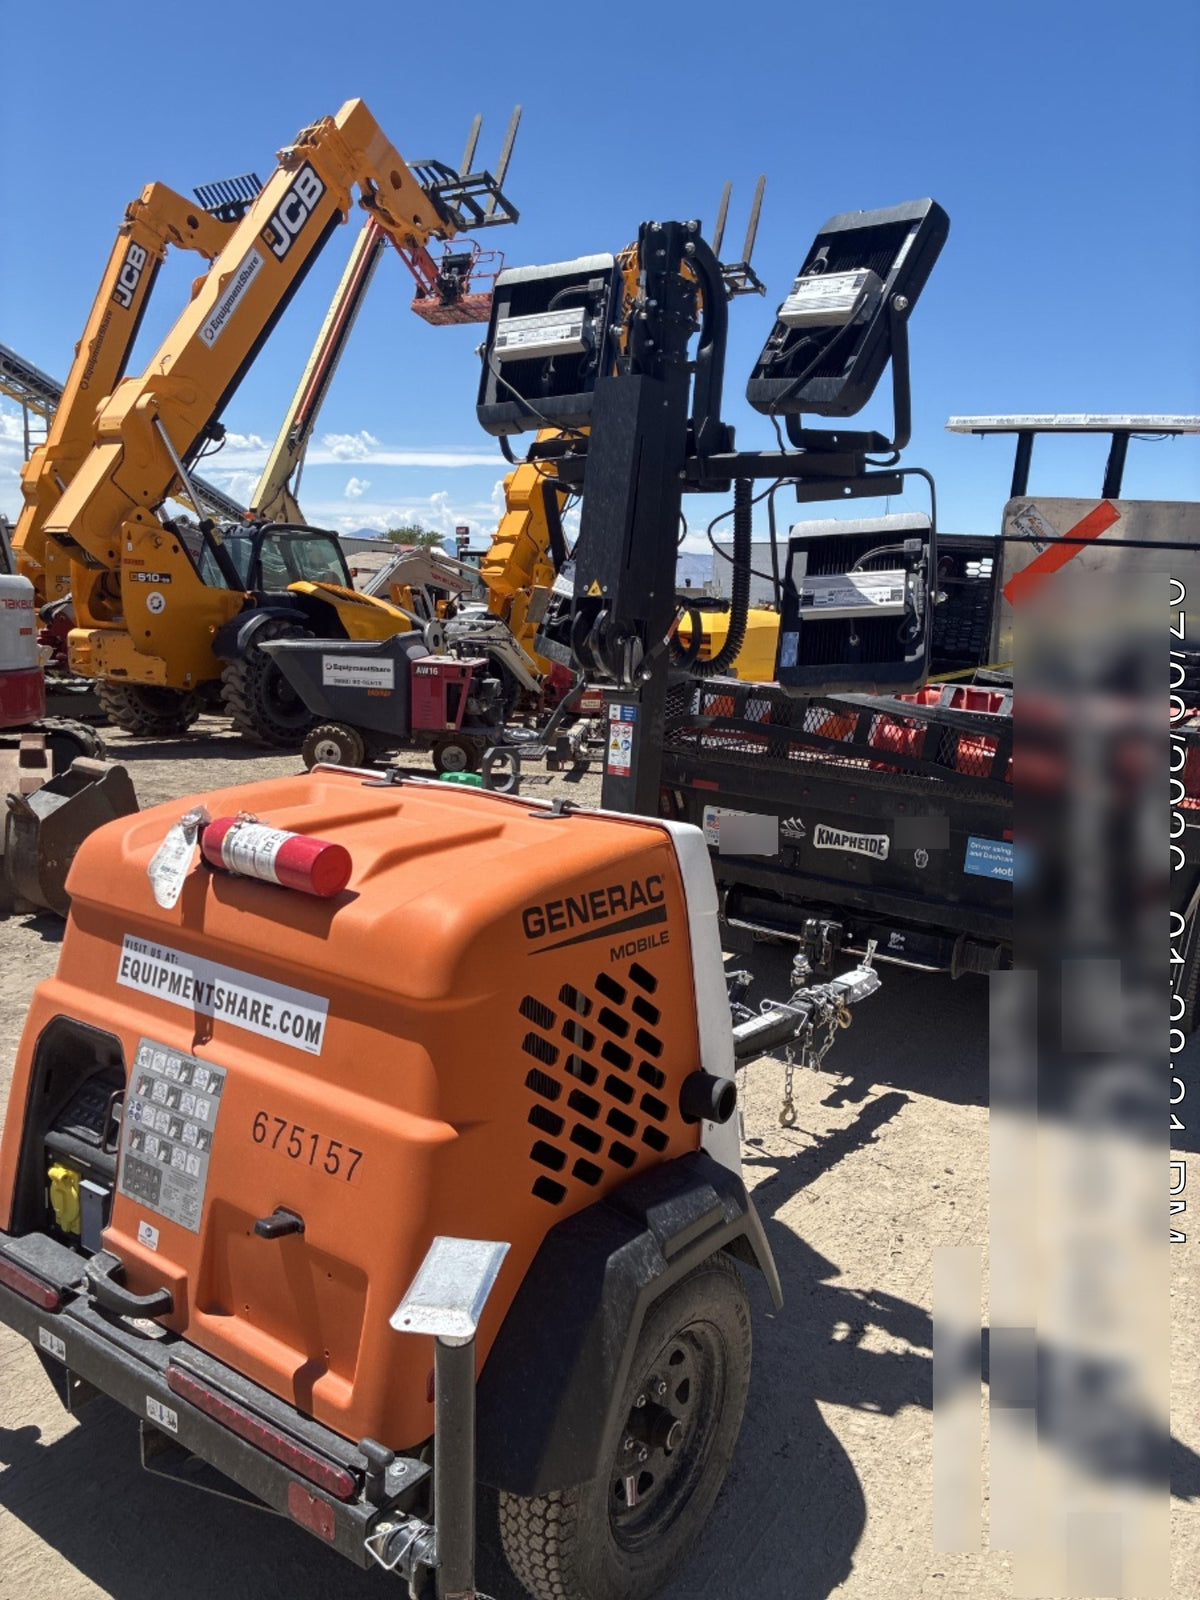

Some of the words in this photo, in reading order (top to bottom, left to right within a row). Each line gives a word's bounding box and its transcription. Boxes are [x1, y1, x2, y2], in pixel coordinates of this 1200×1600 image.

[272, 167, 324, 257] JCB
[116, 243, 148, 309] JCB
[210, 255, 260, 331] EquipmentShare
[416, 666, 438, 675] AW16
[817, 828, 886, 855] KNAPHEIDE
[970, 841, 992, 851] Driver
[993, 846, 1011, 855] using
[522, 875, 665, 940] GENERAC
[125, 939, 148, 954] VISIT
[150, 947, 161, 960] US
[165, 953, 179, 965] AT:
[610, 931, 670, 962] MOBILE
[120, 955, 322, 1045] EQUIPMENTSHARE.COM
[252, 1111, 363, 1181] 675157
